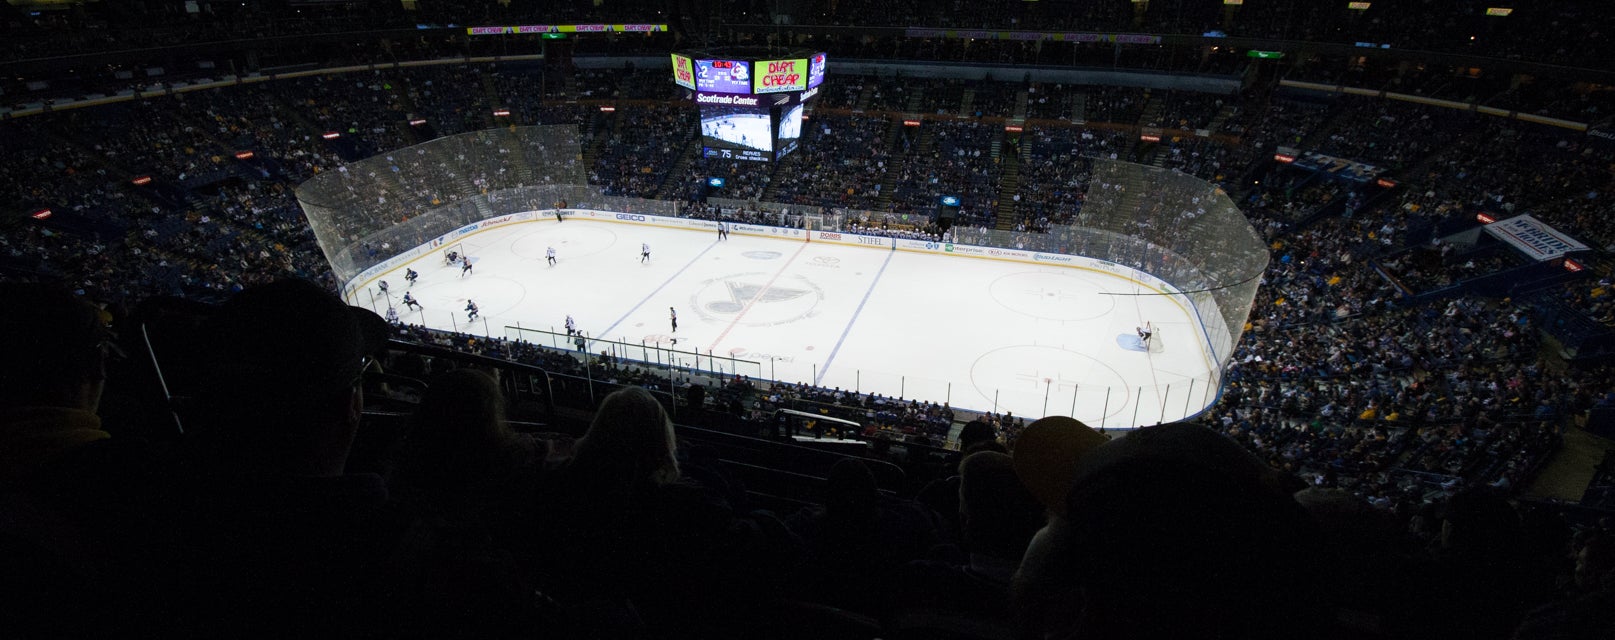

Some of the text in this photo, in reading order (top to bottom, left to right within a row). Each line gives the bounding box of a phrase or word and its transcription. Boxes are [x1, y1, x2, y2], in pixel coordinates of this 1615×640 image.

[701, 65, 708, 77] 2
[768, 61, 795, 73] DIRT
[763, 73, 800, 87] CHEAP
[697, 93, 758, 106] Scottrade Center
[721, 149, 732, 159] 75
[616, 213, 646, 222] GEICO
[857, 236, 884, 245] STIFEL
